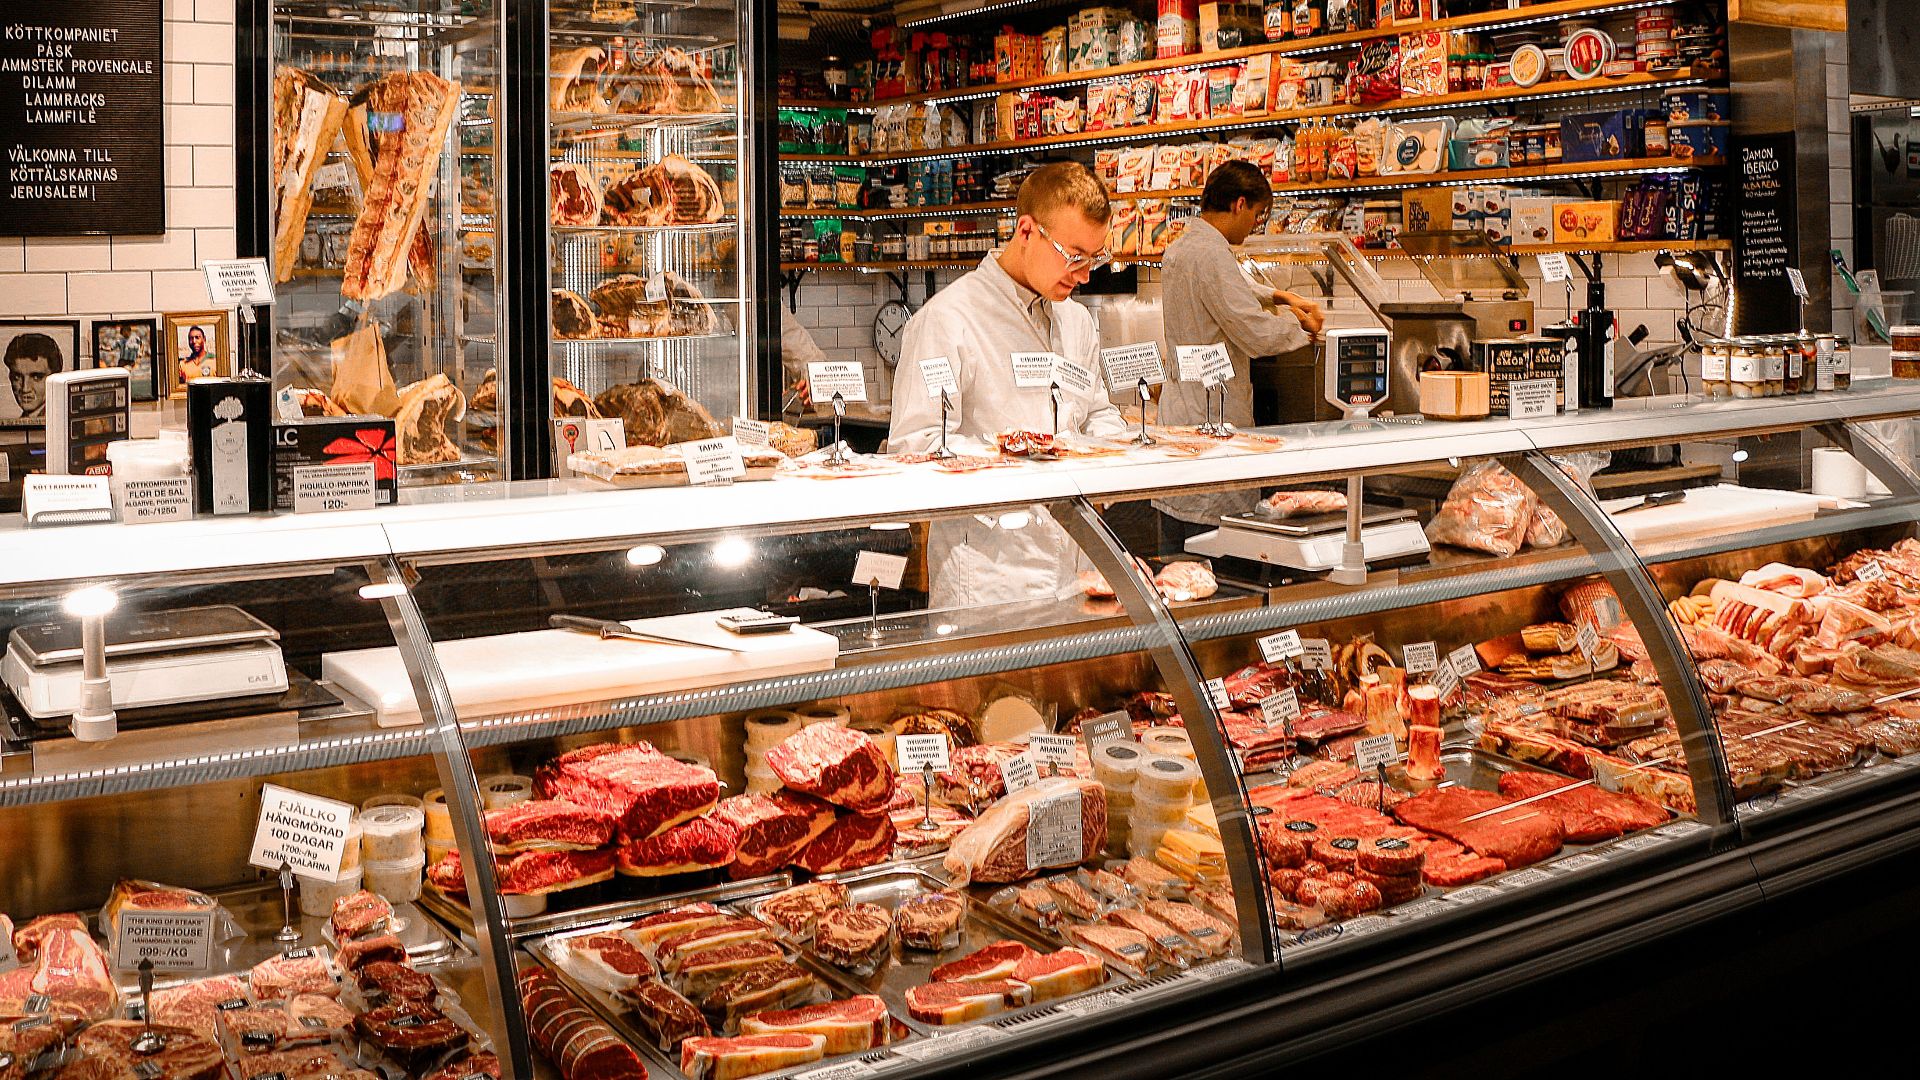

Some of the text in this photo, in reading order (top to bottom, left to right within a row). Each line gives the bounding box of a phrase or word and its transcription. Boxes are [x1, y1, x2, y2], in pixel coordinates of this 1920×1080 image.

[5, 24, 119, 42] KÖTTKOMPANIET
[71, 60, 153, 74] PROVENCALE
[23, 76, 76, 90] DILAMM
[25, 93, 106, 107] LAMMRACKS
[8, 144, 112, 163] VÄLKOMNA TILL
[10, 164, 118, 182] KÖTTÄLSKARNAS
[1743, 160, 1779, 174] IBERICO
[10, 184, 88, 199] JERUSALEM
[1409, 211, 1430, 223] CACAO
[276, 428, 298, 446] LC
[129, 491, 152, 499] FLOR
[156, 498, 190, 506] PORTUGAL
[279, 800, 337, 823] FJÄLLKO
[265, 811, 344, 839] HÄNGMÖRAD
[271, 828, 334, 852] 100 DAGAR
[290, 856, 331, 873] DALARNA
[127, 927, 204, 938] PORTERHOUSE
